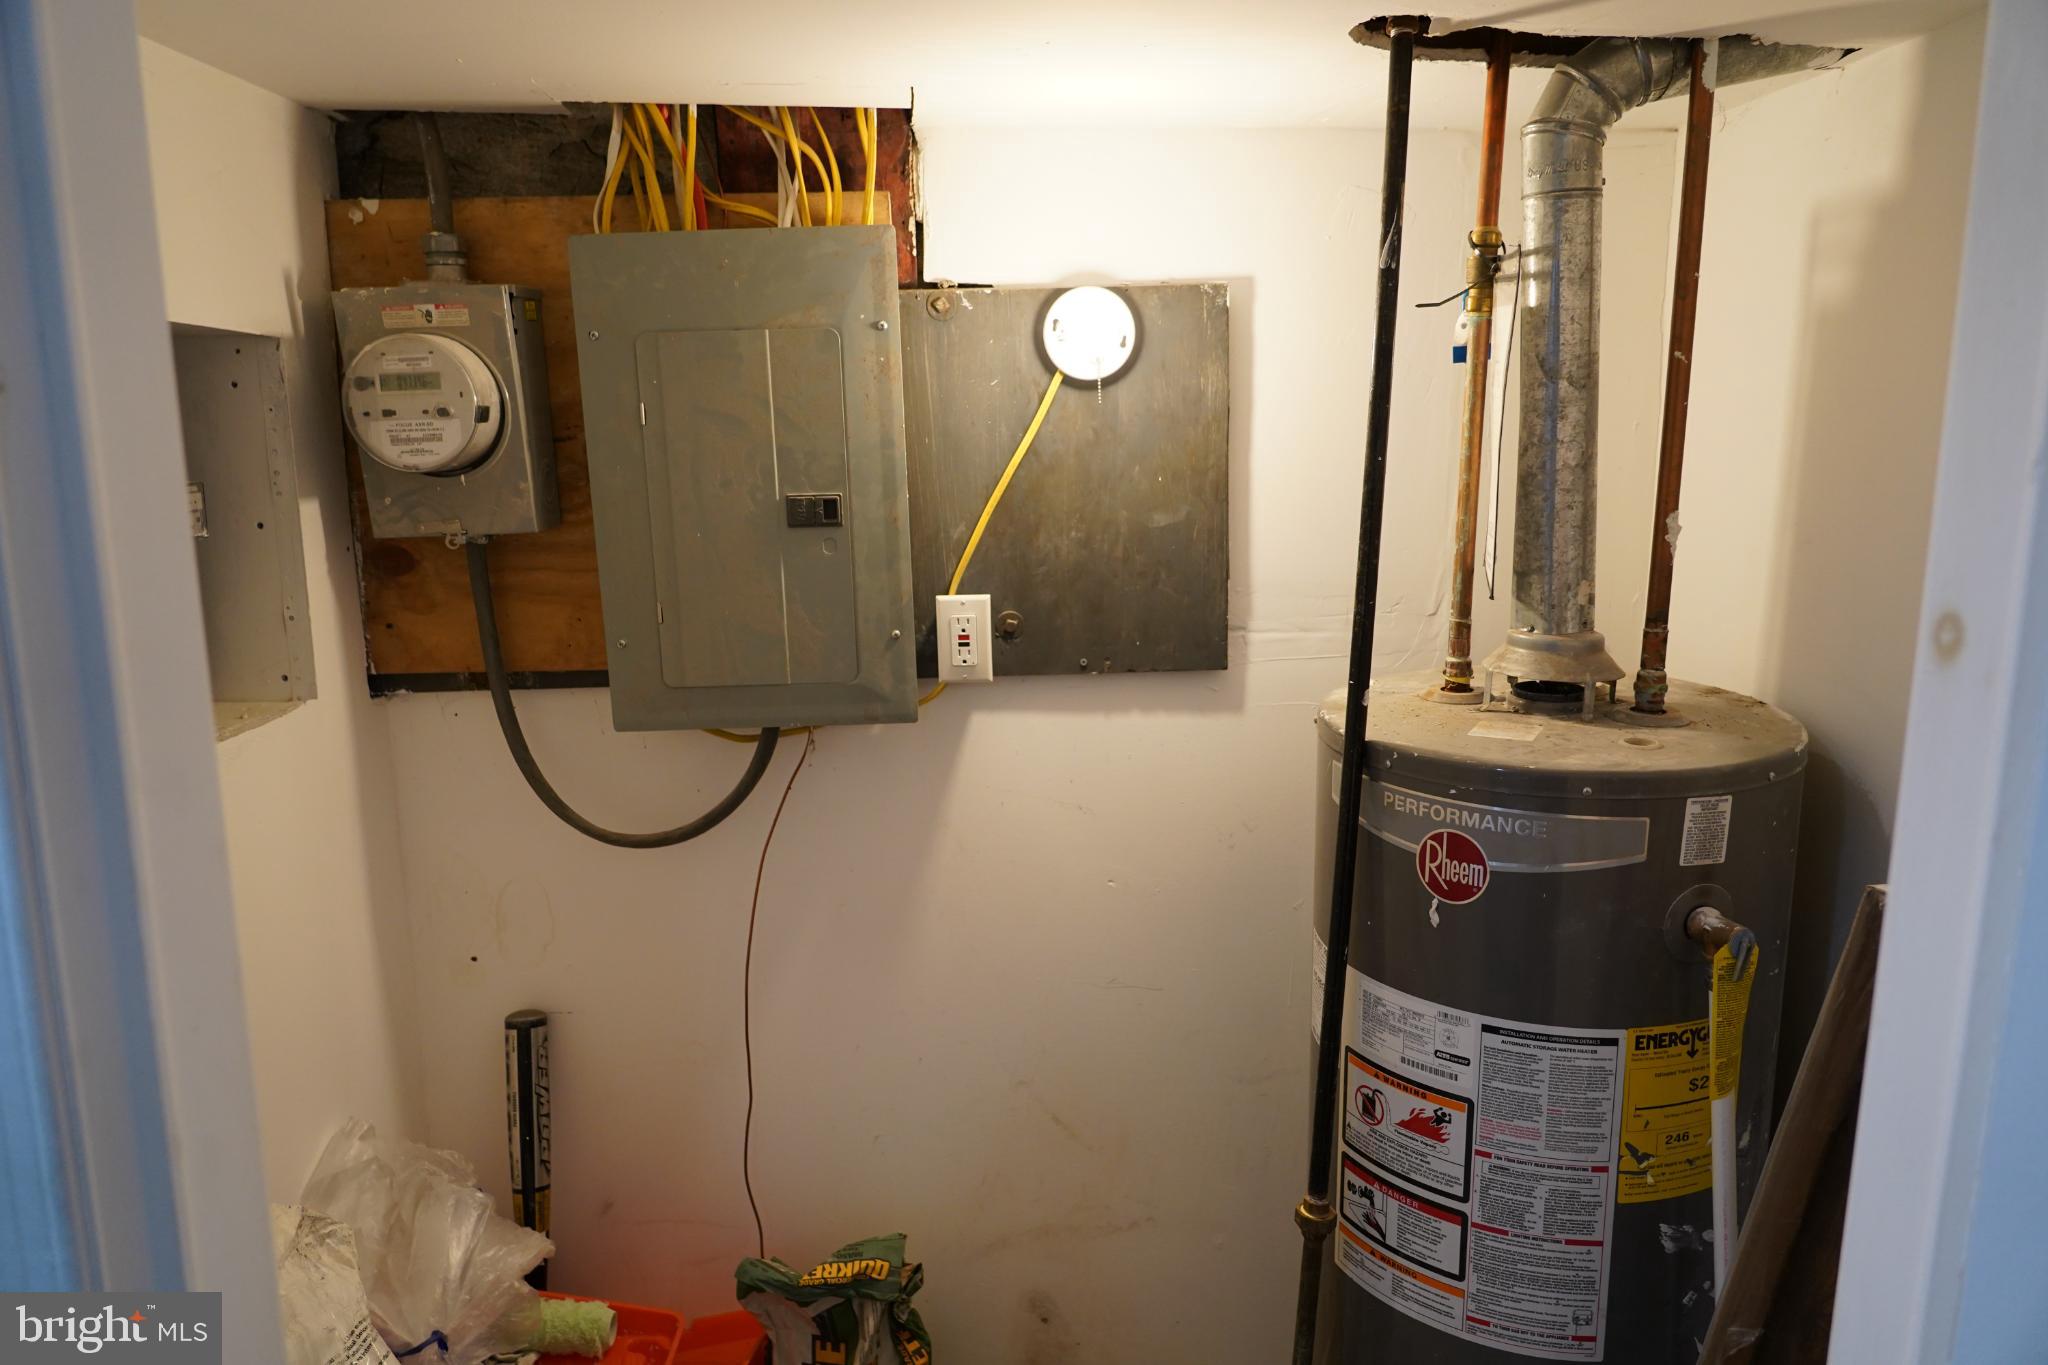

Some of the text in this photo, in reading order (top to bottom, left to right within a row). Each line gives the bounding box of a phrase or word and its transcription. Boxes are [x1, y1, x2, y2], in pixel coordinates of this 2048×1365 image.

[1384, 790, 1548, 839] PERFORMANCE
[1424, 831, 1484, 889] Rheem
[1382, 1075, 1428, 1100] WARNING
[1665, 1131, 1689, 1145] 246
[1381, 1185, 1419, 1208] DANGER
[1380, 1254, 1418, 1279] WARNING
